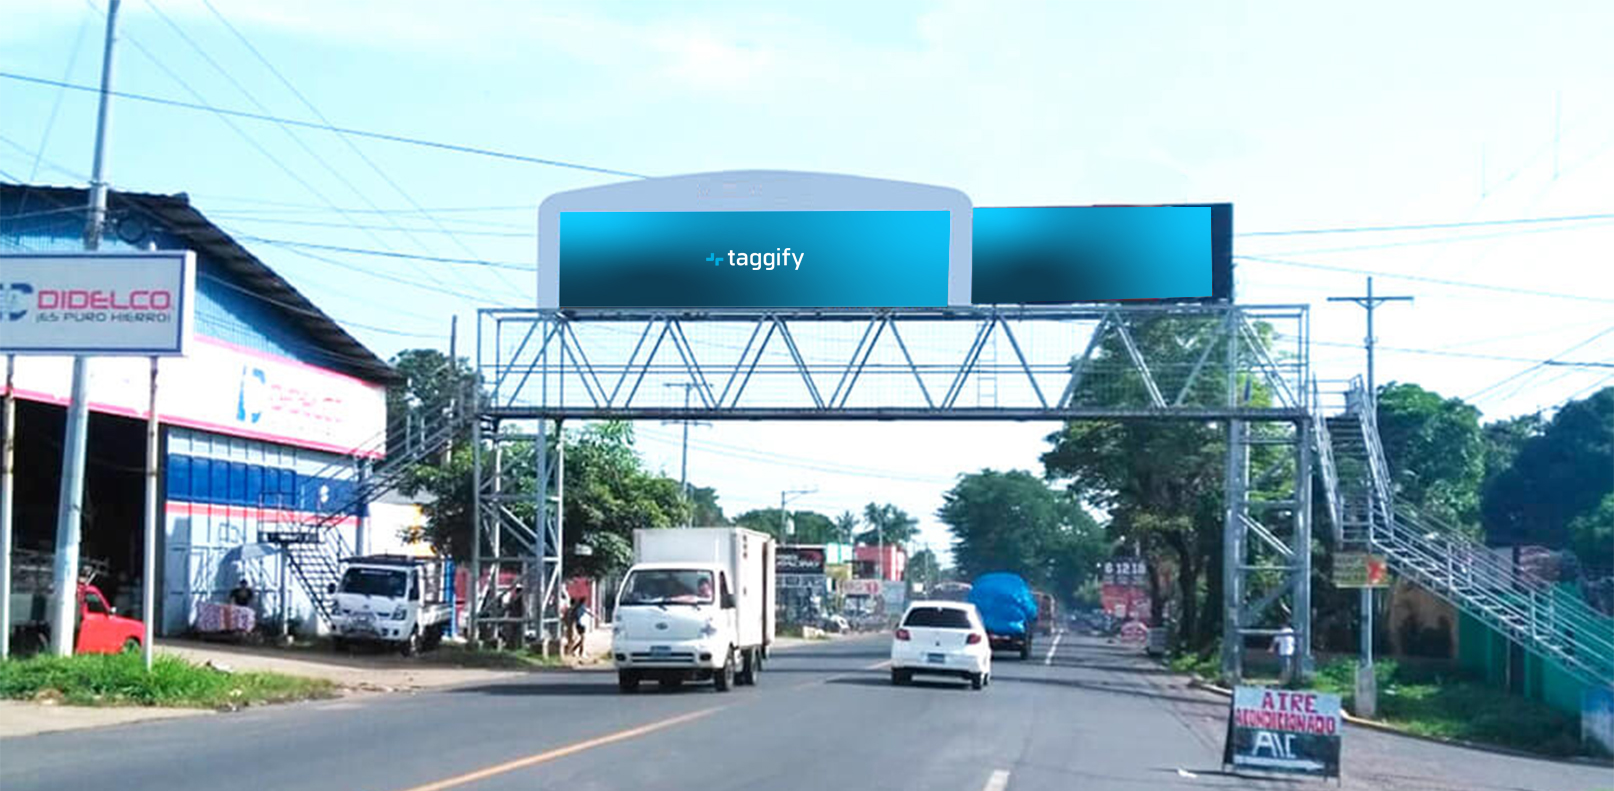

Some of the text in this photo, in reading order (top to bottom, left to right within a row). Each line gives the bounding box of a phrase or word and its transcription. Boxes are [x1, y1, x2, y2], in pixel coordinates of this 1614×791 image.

[727, 247, 805, 271] taggify
[37, 290, 171, 310] DIDELCO
[63, 312, 108, 323] PURO
[1262, 691, 1318, 714] AIRE
